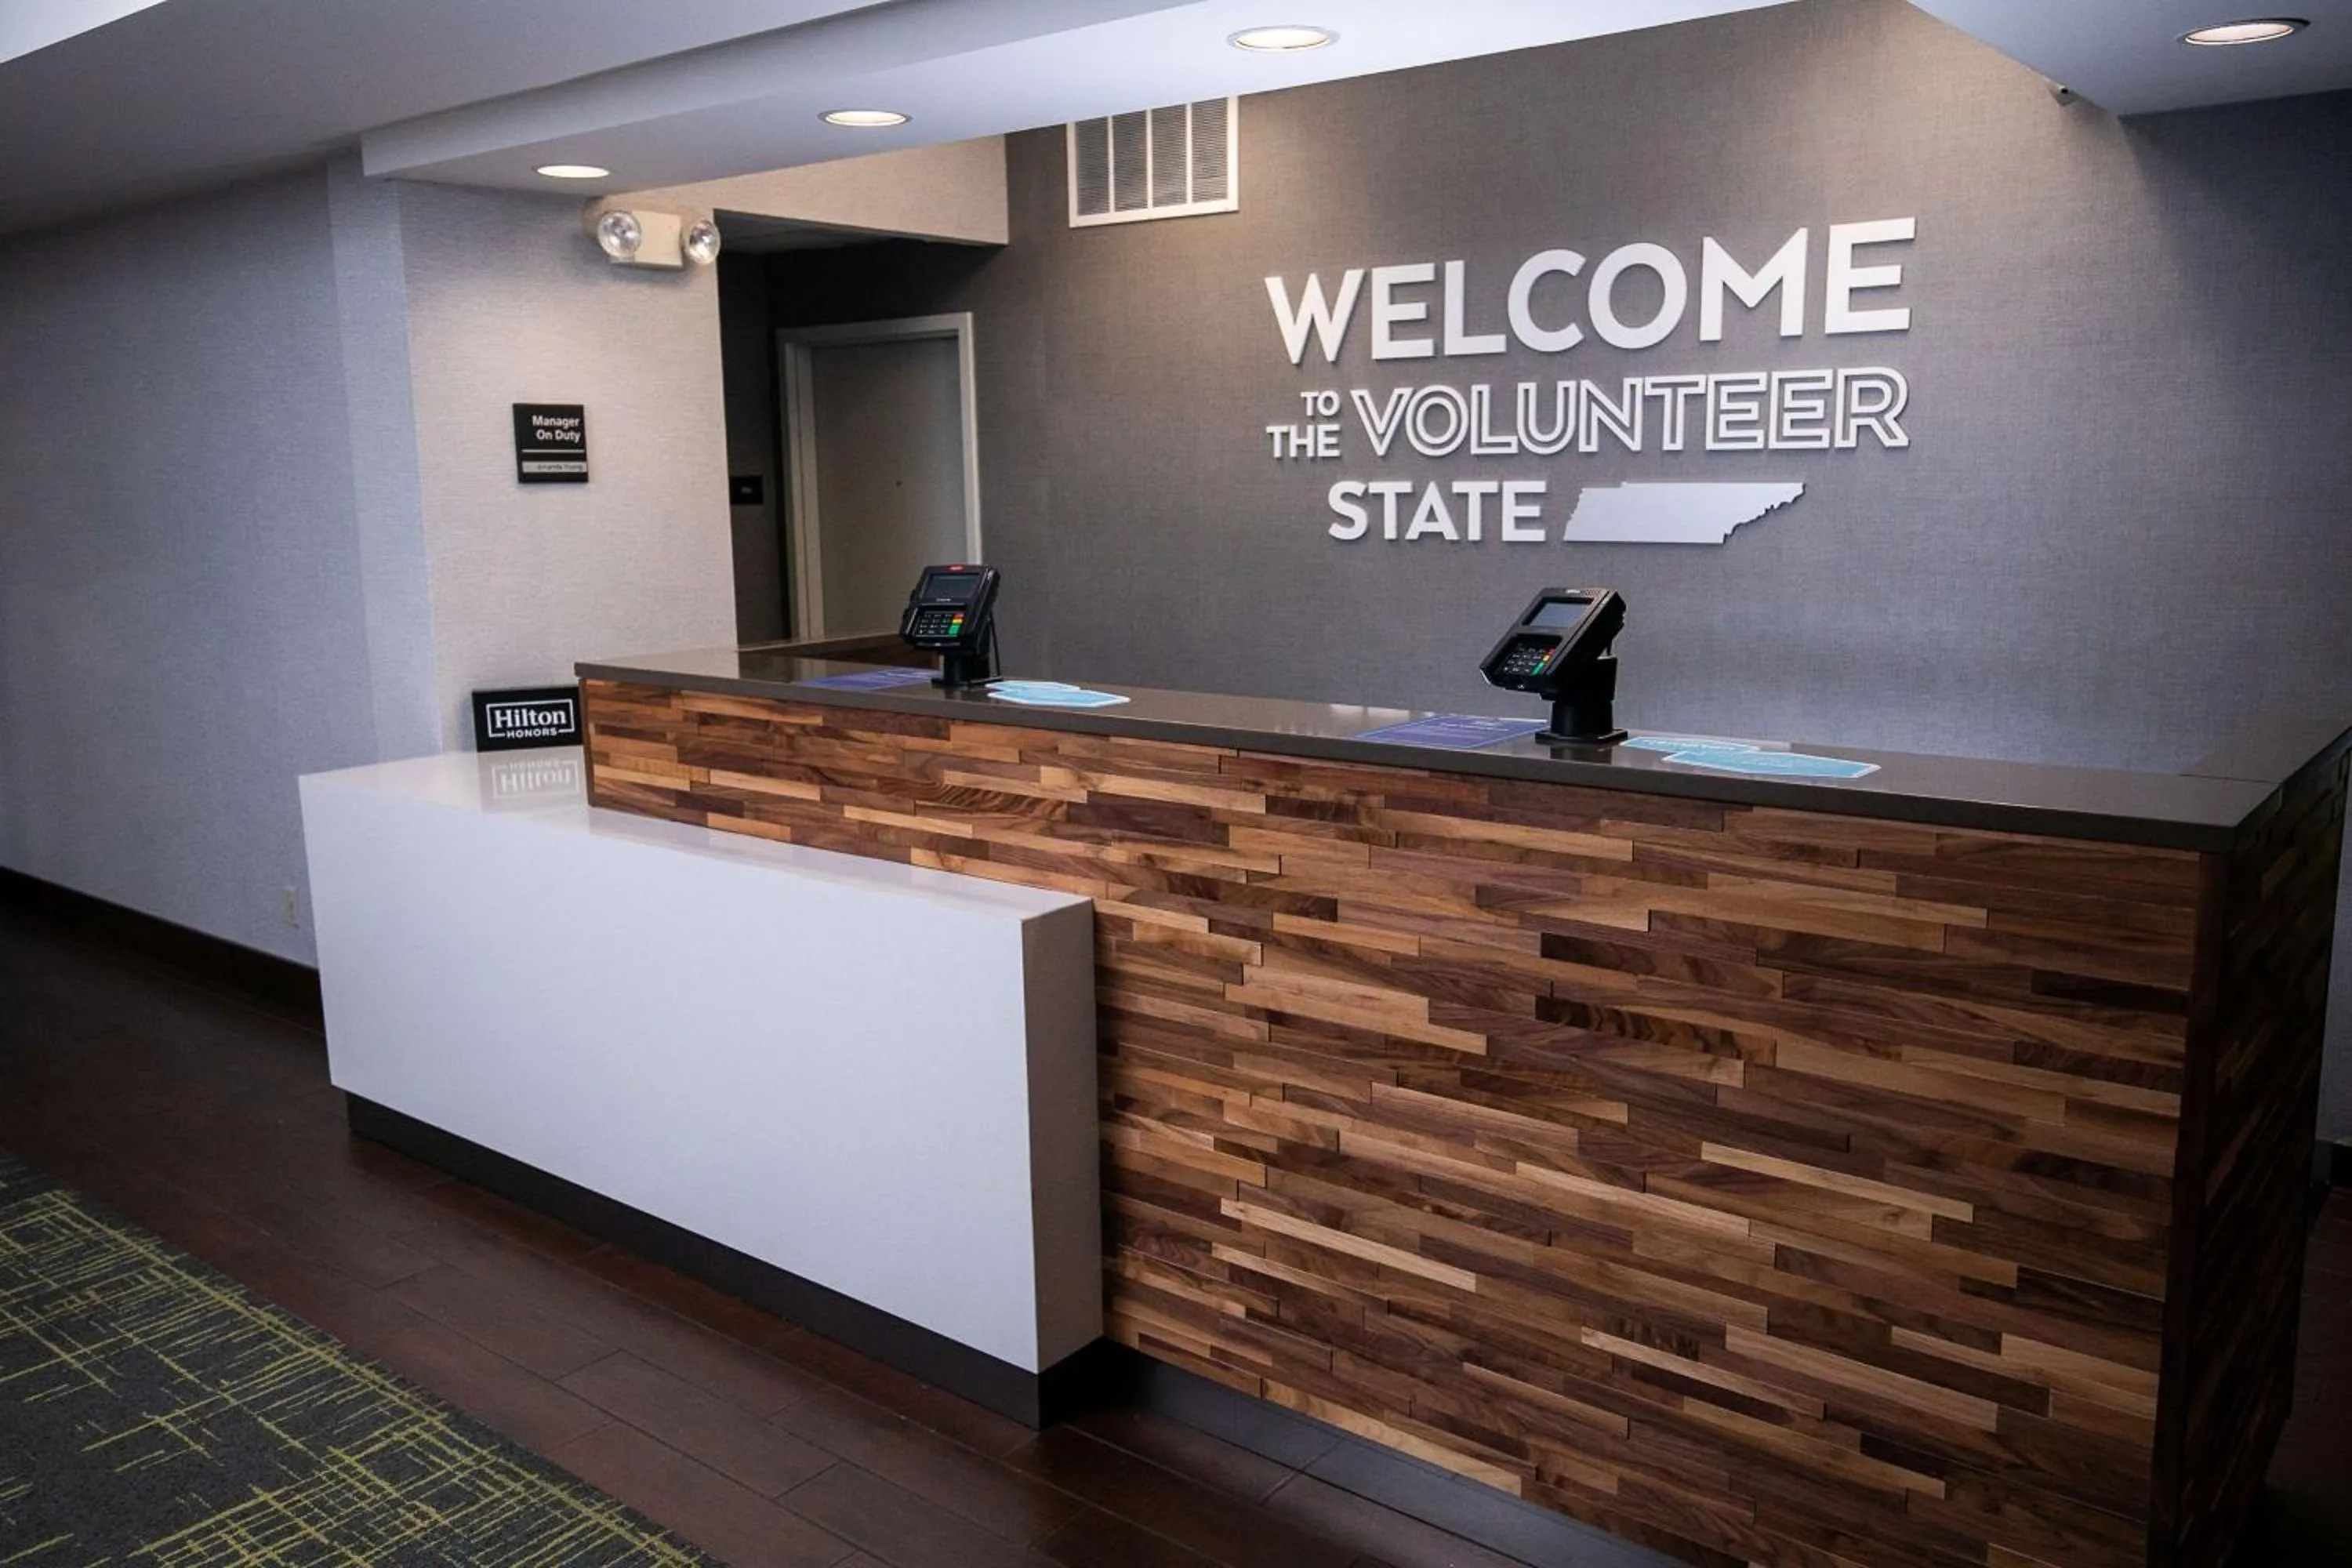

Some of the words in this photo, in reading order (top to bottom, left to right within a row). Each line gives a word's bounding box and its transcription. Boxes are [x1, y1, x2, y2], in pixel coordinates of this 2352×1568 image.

[1265, 217, 1915, 364] WELCOME
[1301, 390, 1341, 417] TO
[1350, 366, 1910, 456] VOLUNTEER
[532, 415, 580, 430] Manager
[536, 429, 553, 441] On
[554, 430, 581, 443] Duty
[1266, 424, 1341, 457] THE
[1327, 480, 1547, 542] STATE
[495, 708, 568, 728] Hilton
[506, 728, 558, 739] HONORS
